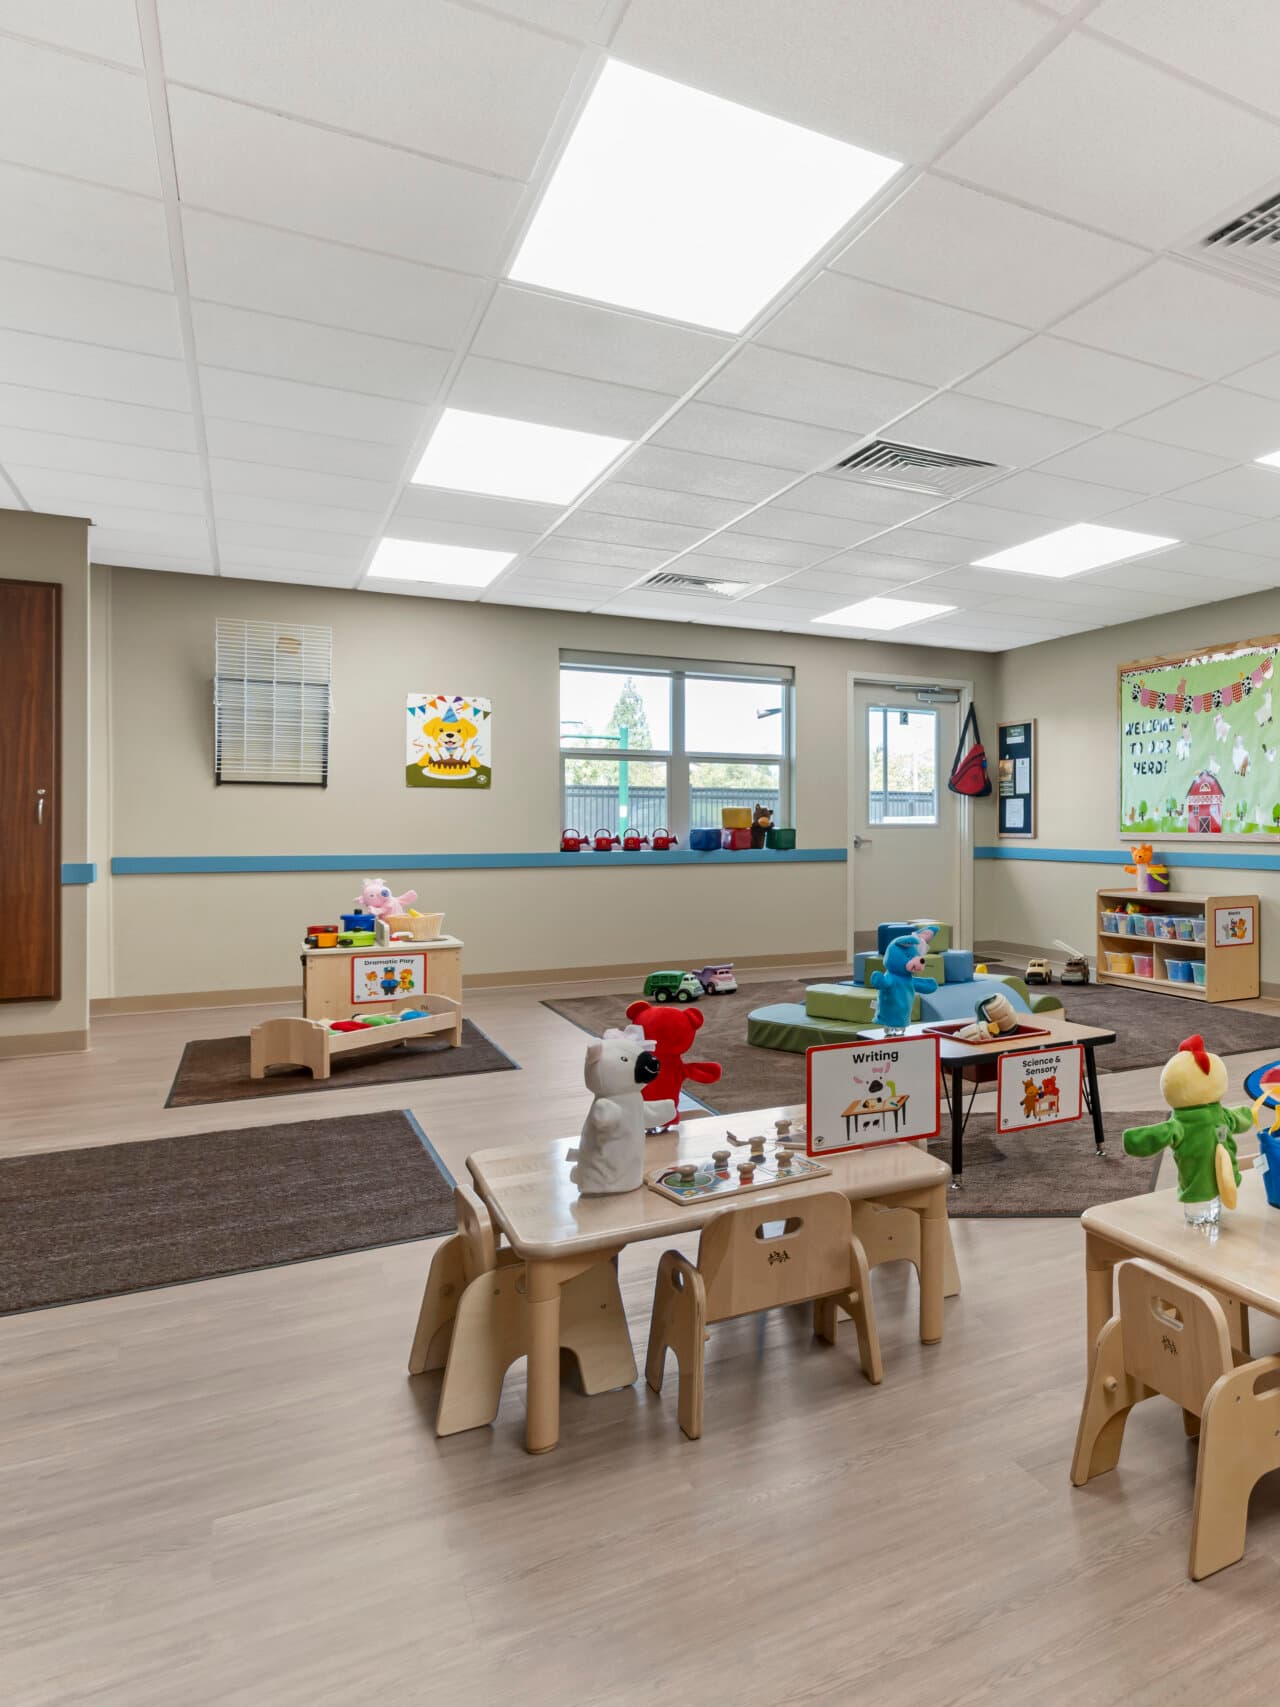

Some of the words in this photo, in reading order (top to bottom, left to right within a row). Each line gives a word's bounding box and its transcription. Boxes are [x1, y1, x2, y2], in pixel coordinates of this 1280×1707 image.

[1133, 760, 1168, 775] HERD!
[852, 1050, 899, 1064] Writing
[1022, 1057, 1054, 1068] Science
[1054, 1055, 1061, 1063] &
[1025, 1065, 1058, 1076] Sensory
